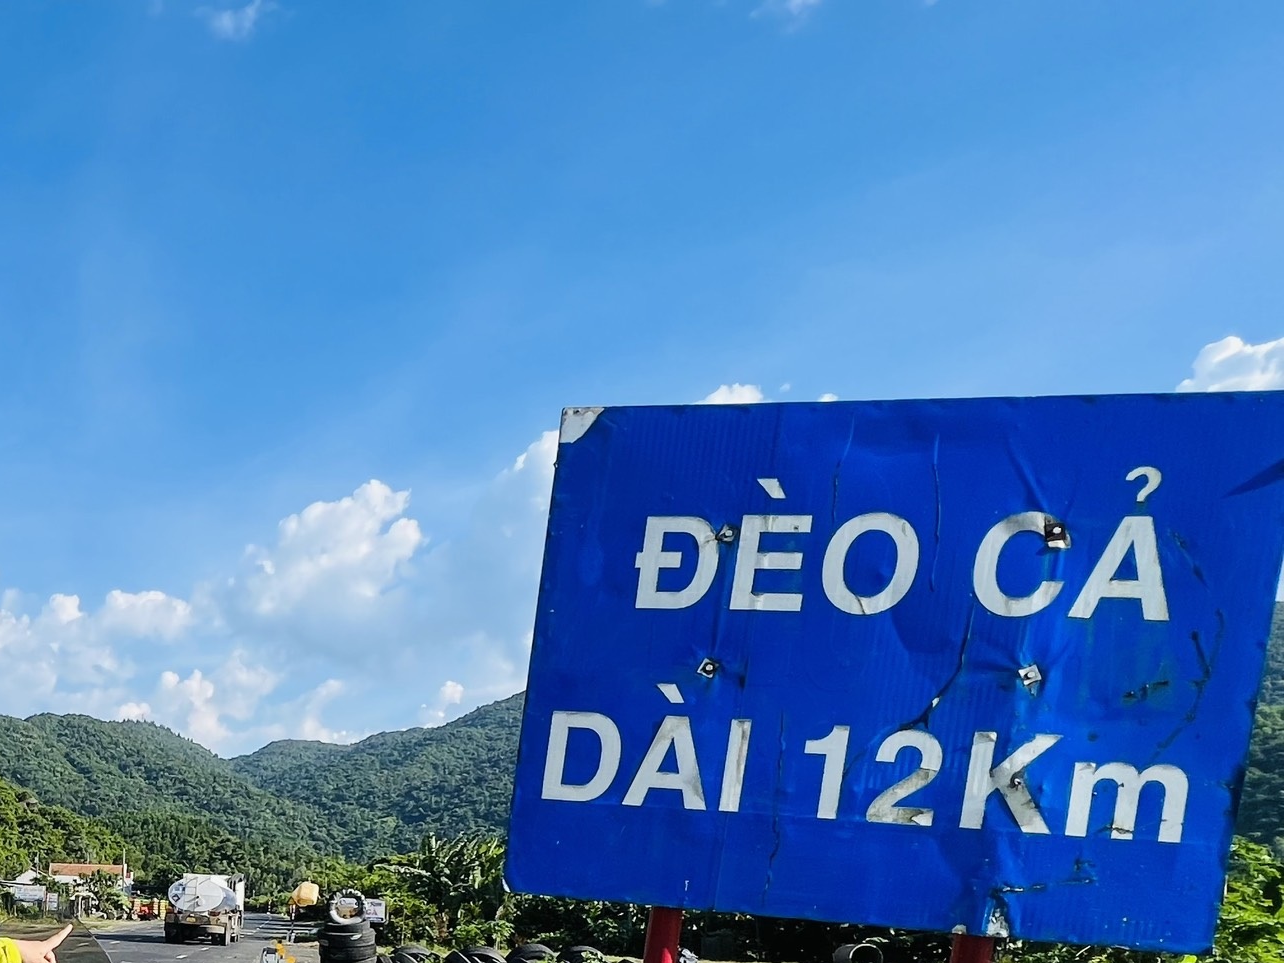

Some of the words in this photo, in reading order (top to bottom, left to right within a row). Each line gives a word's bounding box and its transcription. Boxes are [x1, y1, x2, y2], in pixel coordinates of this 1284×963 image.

[634, 477, 920, 615] ĐÈO
[972, 465, 1171, 622] CẢ
[540, 682, 752, 813] DÀI
